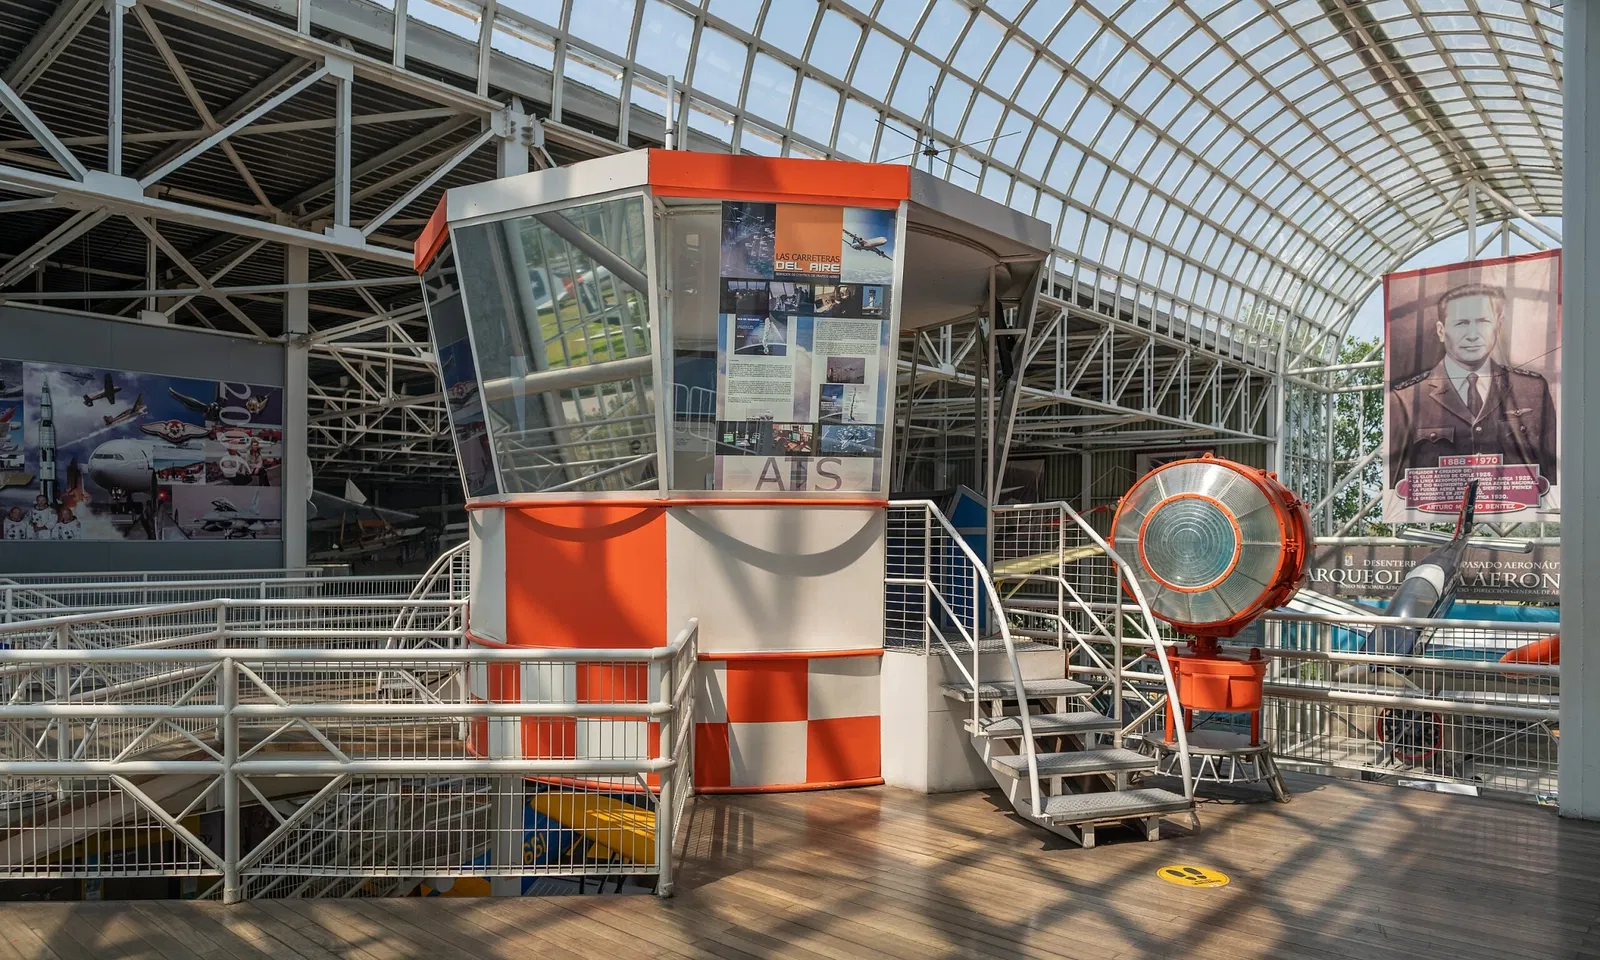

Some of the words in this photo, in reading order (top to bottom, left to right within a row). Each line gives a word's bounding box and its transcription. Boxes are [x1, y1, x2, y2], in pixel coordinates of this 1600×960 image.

[776, 253, 789, 261] LAS
[791, 253, 840, 263] CARRETERAS
[775, 261, 803, 271] DEL
[809, 262, 840, 273] AIRE
[755, 456, 843, 491] ATS
[1364, 559, 1417, 567] DESENTERR
[1462, 561, 1502, 569] PASADO
